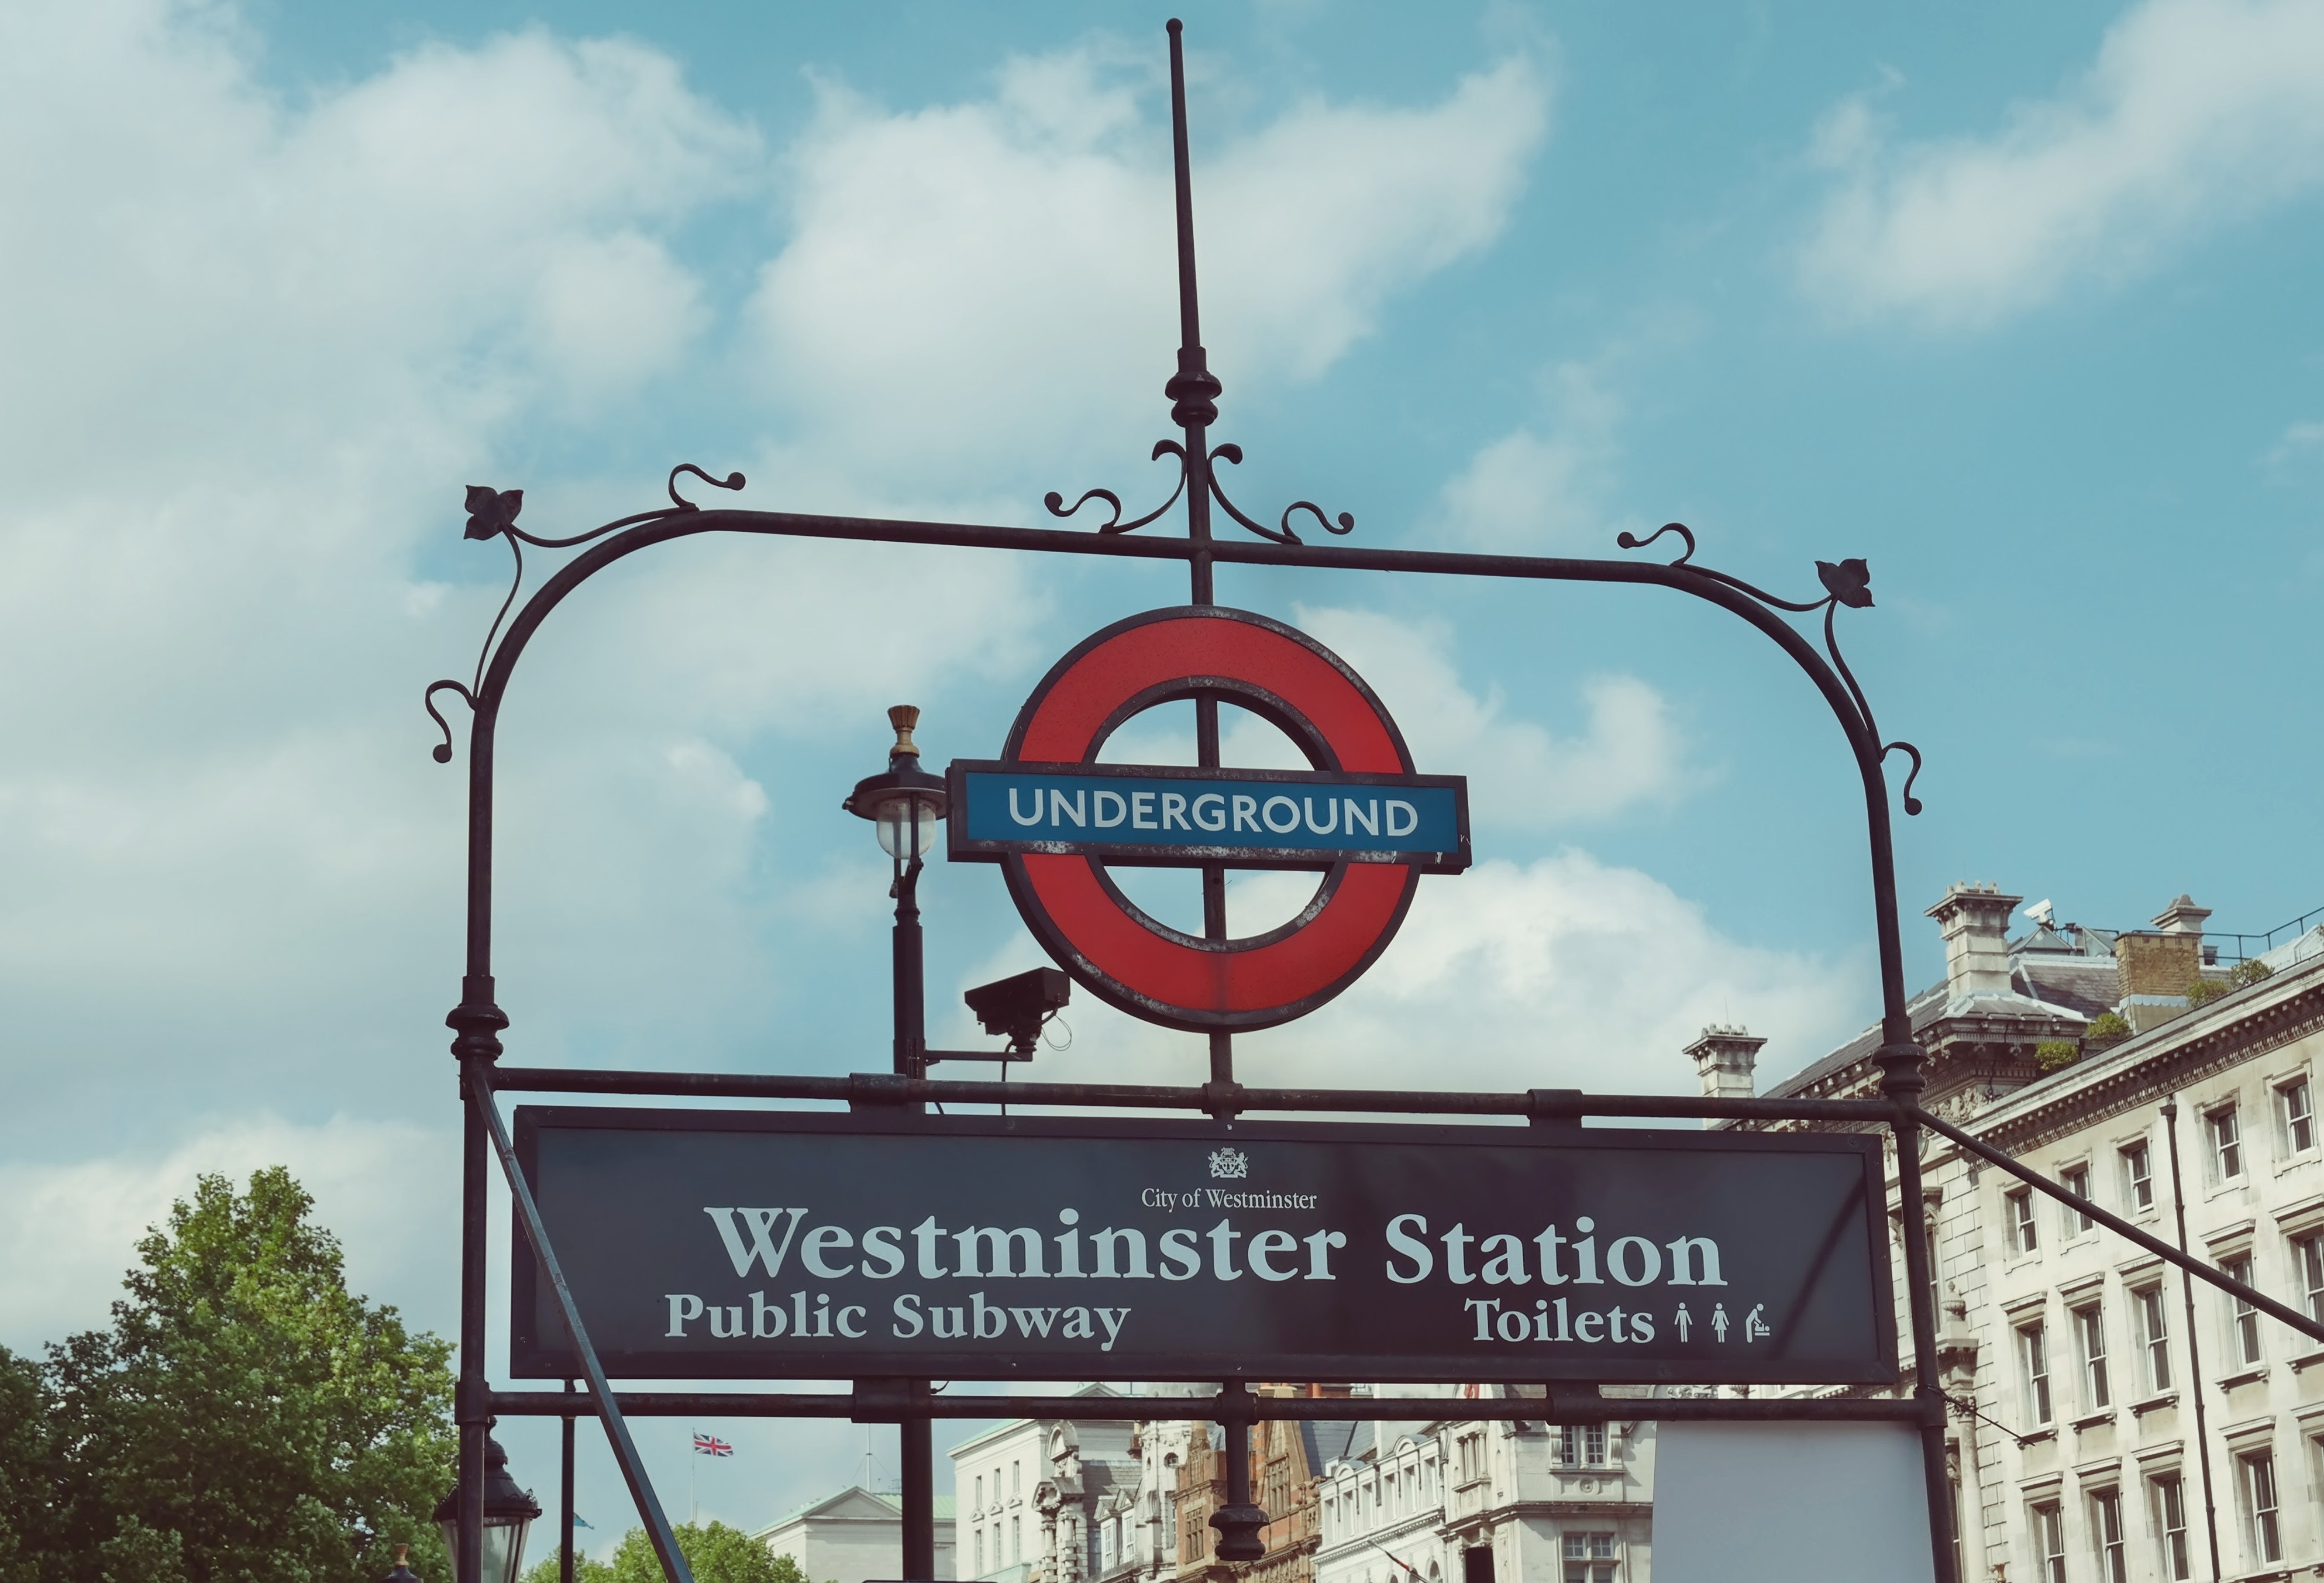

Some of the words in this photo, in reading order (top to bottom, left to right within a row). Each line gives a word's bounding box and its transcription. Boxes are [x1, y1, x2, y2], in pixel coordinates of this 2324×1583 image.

[1009, 788, 1418, 837] UNDERGROUND
[1141, 1188, 1178, 1213] City
[1182, 1188, 1201, 1207] of
[1205, 1189, 1317, 1209] Westminster
[703, 1207, 1347, 1282] Westminster
[1386, 1213, 1728, 1286] Station
[665, 1290, 867, 1338] Public
[893, 1291, 1132, 1351] Subway
[1464, 1297, 1655, 1344] Toilets
